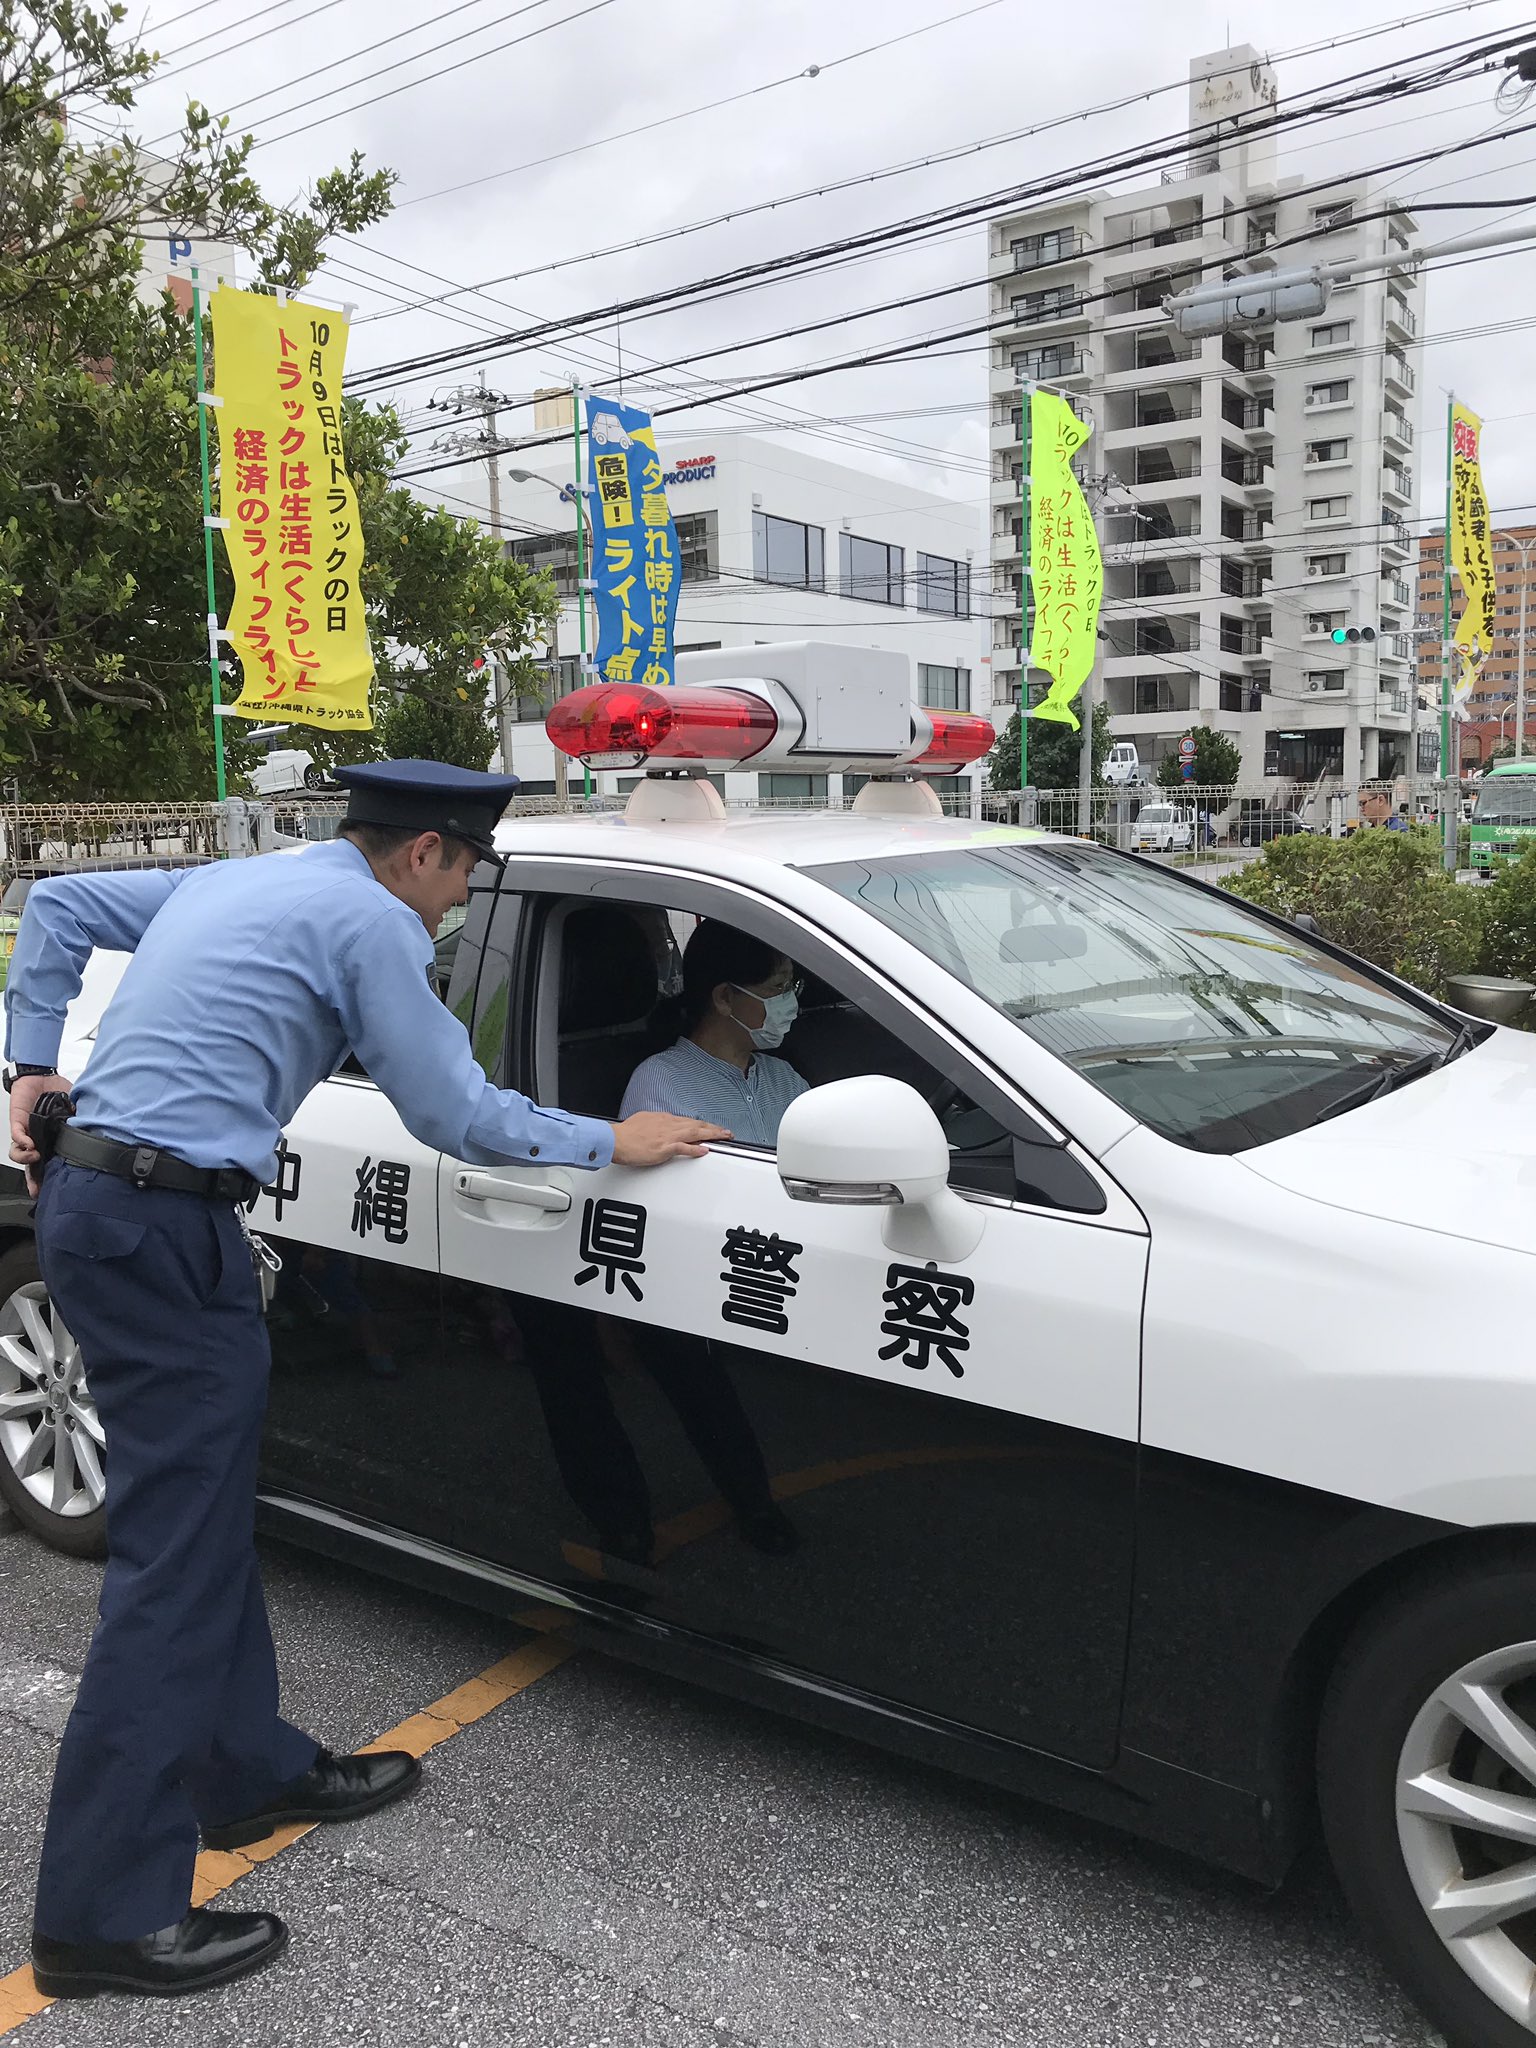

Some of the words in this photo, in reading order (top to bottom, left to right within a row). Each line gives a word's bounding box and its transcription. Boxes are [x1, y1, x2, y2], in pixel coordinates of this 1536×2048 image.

[169, 231, 192, 261] P
[675, 455, 716, 470] SHARP
[309, 321, 351, 632] 10月9日はトラックの日
[662, 465, 716, 486] PRODUCT
[233, 427, 286, 699] 経済のライフライン
[1183, 742, 1194, 751] 30
